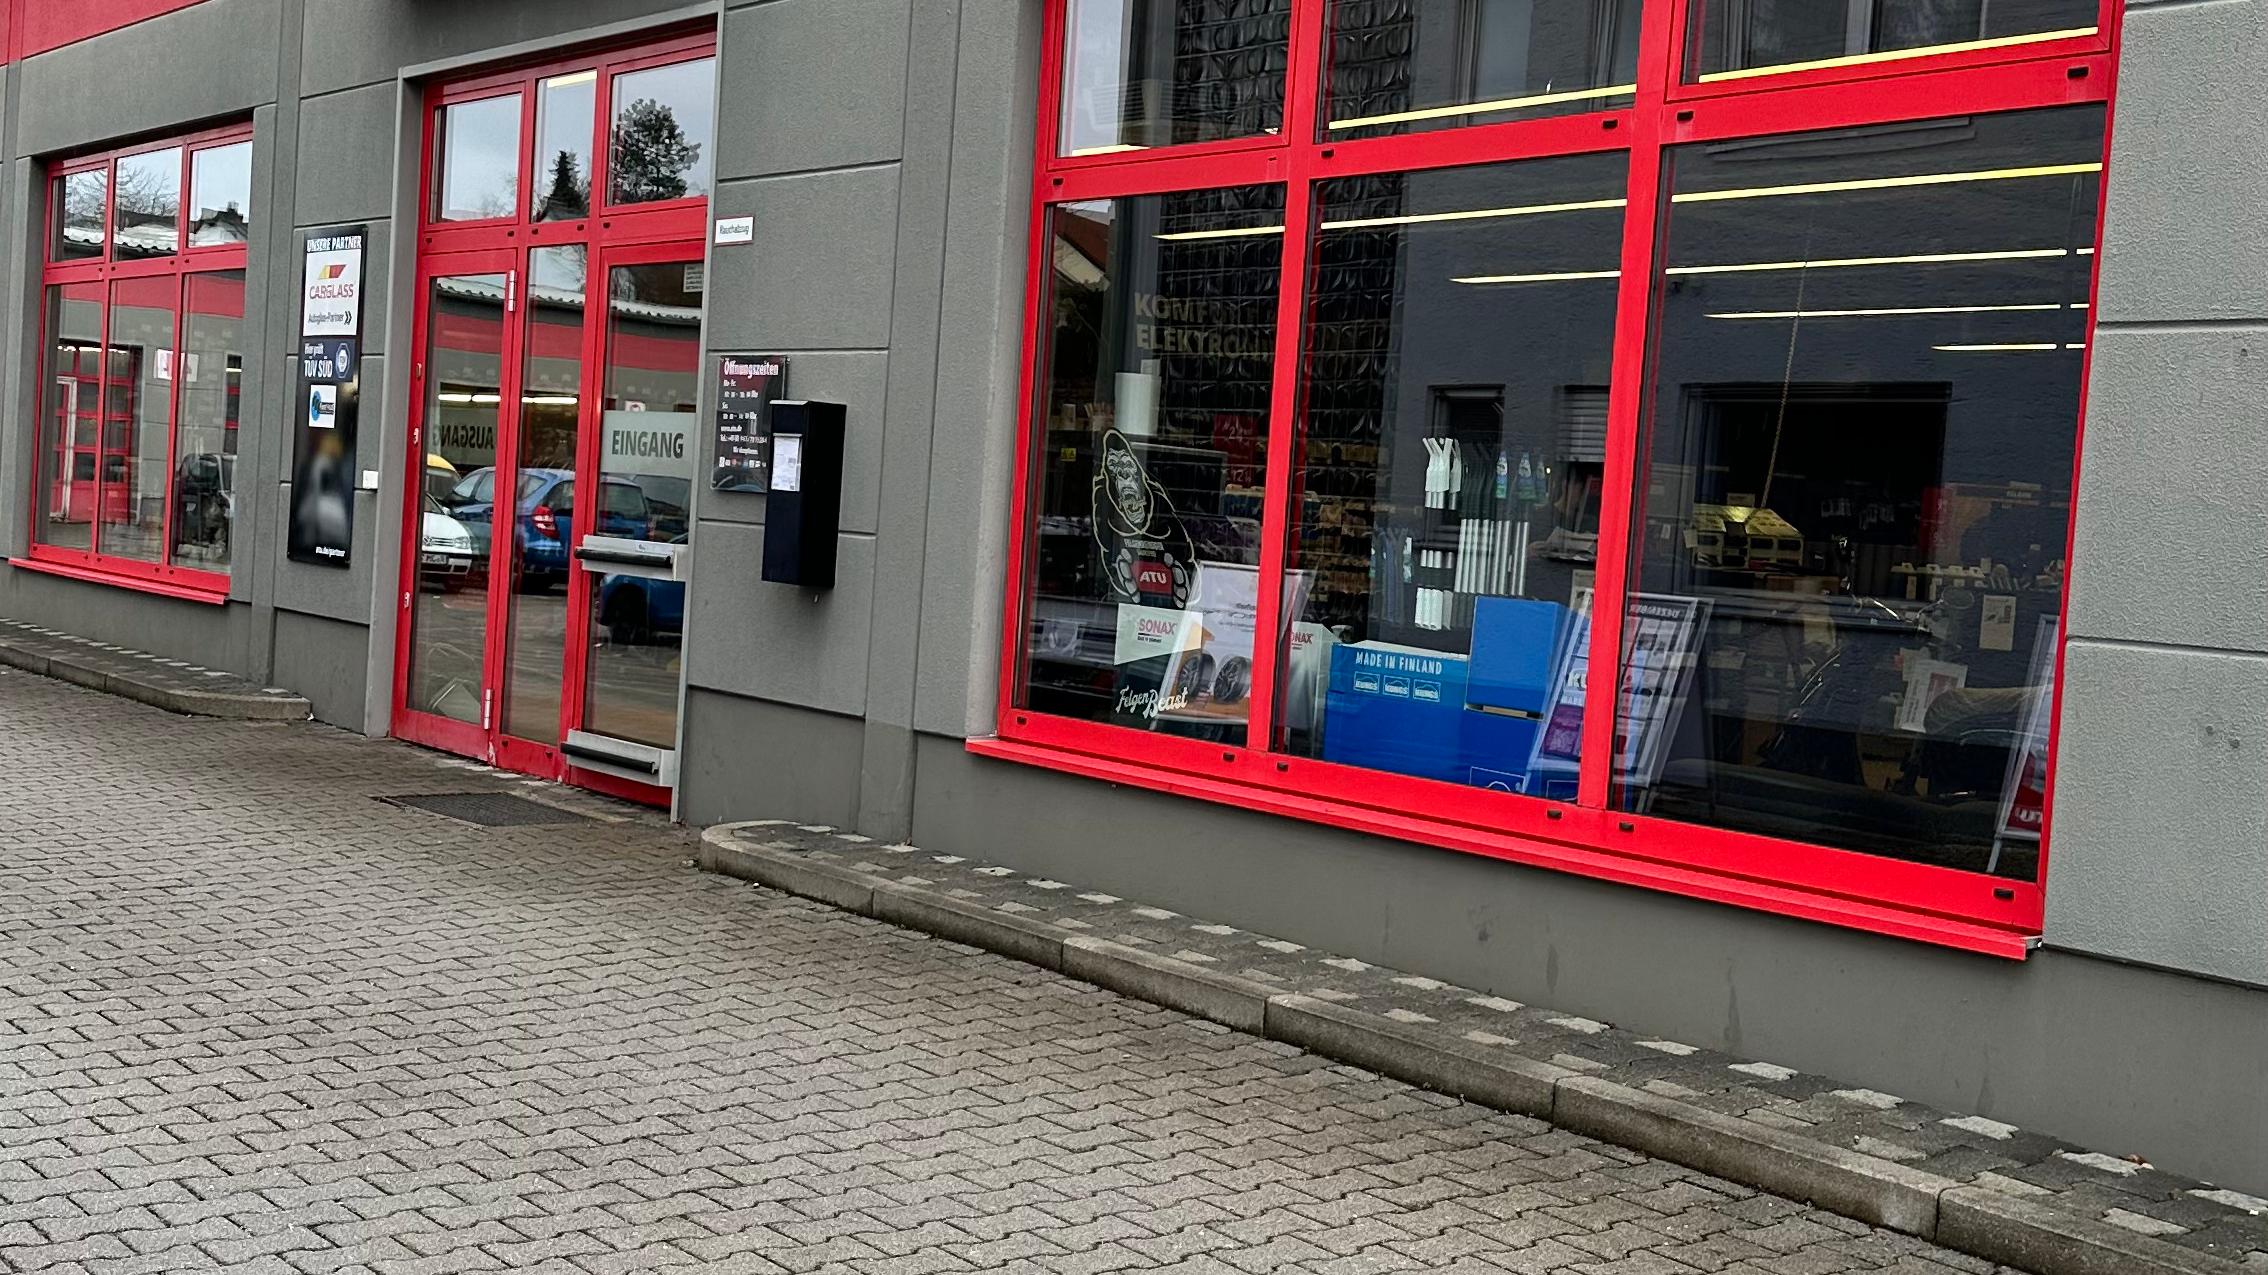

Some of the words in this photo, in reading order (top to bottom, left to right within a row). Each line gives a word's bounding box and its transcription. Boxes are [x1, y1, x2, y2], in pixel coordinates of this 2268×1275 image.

[306, 237, 331, 252] UNSERE
[332, 235, 362, 250] PARTNER
[309, 284, 354, 299] CARGLASS
[304, 355, 317, 377] TÜV
[318, 355, 333, 377] SÜD
[724, 358, 779, 379] Öffnungszeiten
[611, 430, 684, 459] EINGANG
[1139, 571, 1168, 584] ATU
[1138, 618, 1177, 636] SONAX
[1355, 651, 1382, 668] MADE
[1384, 655, 1396, 669] IN
[1399, 656, 1443, 675] FINLAND
[1115, 685, 1150, 713] Felgen
[1142, 686, 1189, 719] Beast
